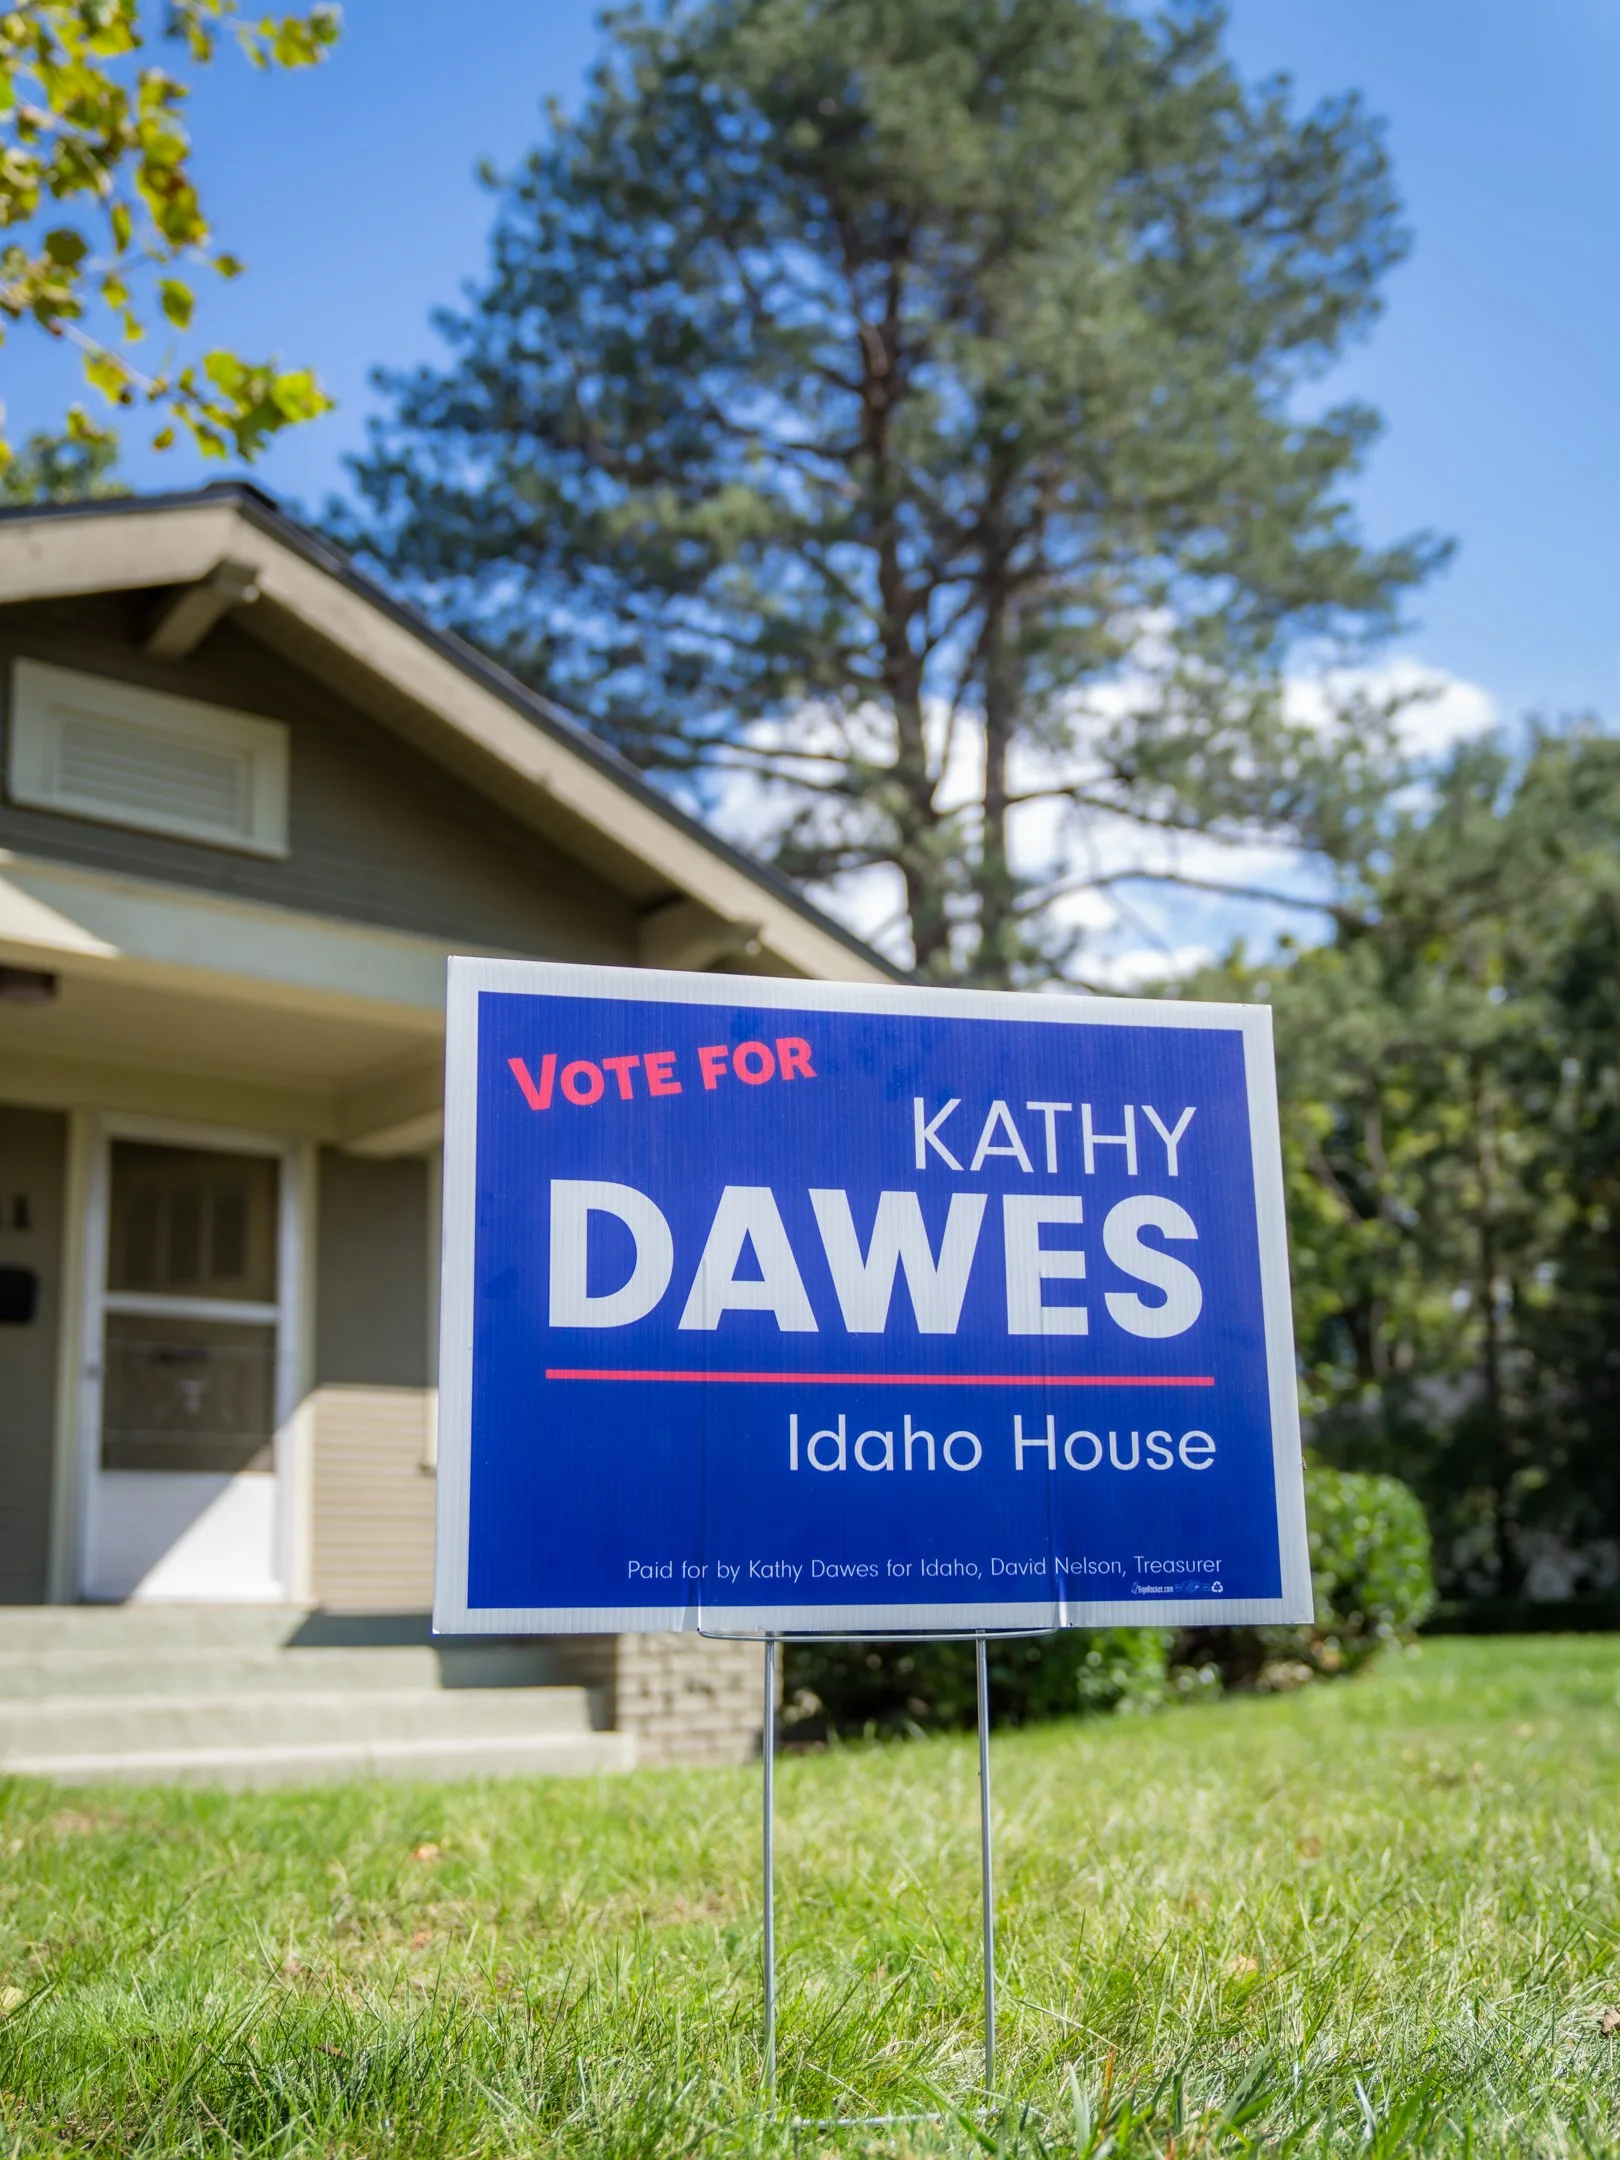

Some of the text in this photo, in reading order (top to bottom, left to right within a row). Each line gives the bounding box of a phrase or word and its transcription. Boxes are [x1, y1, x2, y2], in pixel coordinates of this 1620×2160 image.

[508, 1037, 816, 1110] VOTE FOR
[914, 1097, 1196, 1176] KATHY
[549, 1179, 1202, 1338] DAWES
[790, 1414, 1215, 1471] Idaho House
[628, 1555, 1222, 1583] Paid for by Kathy Dawes for Idaho, David Nelson, Treasurer
